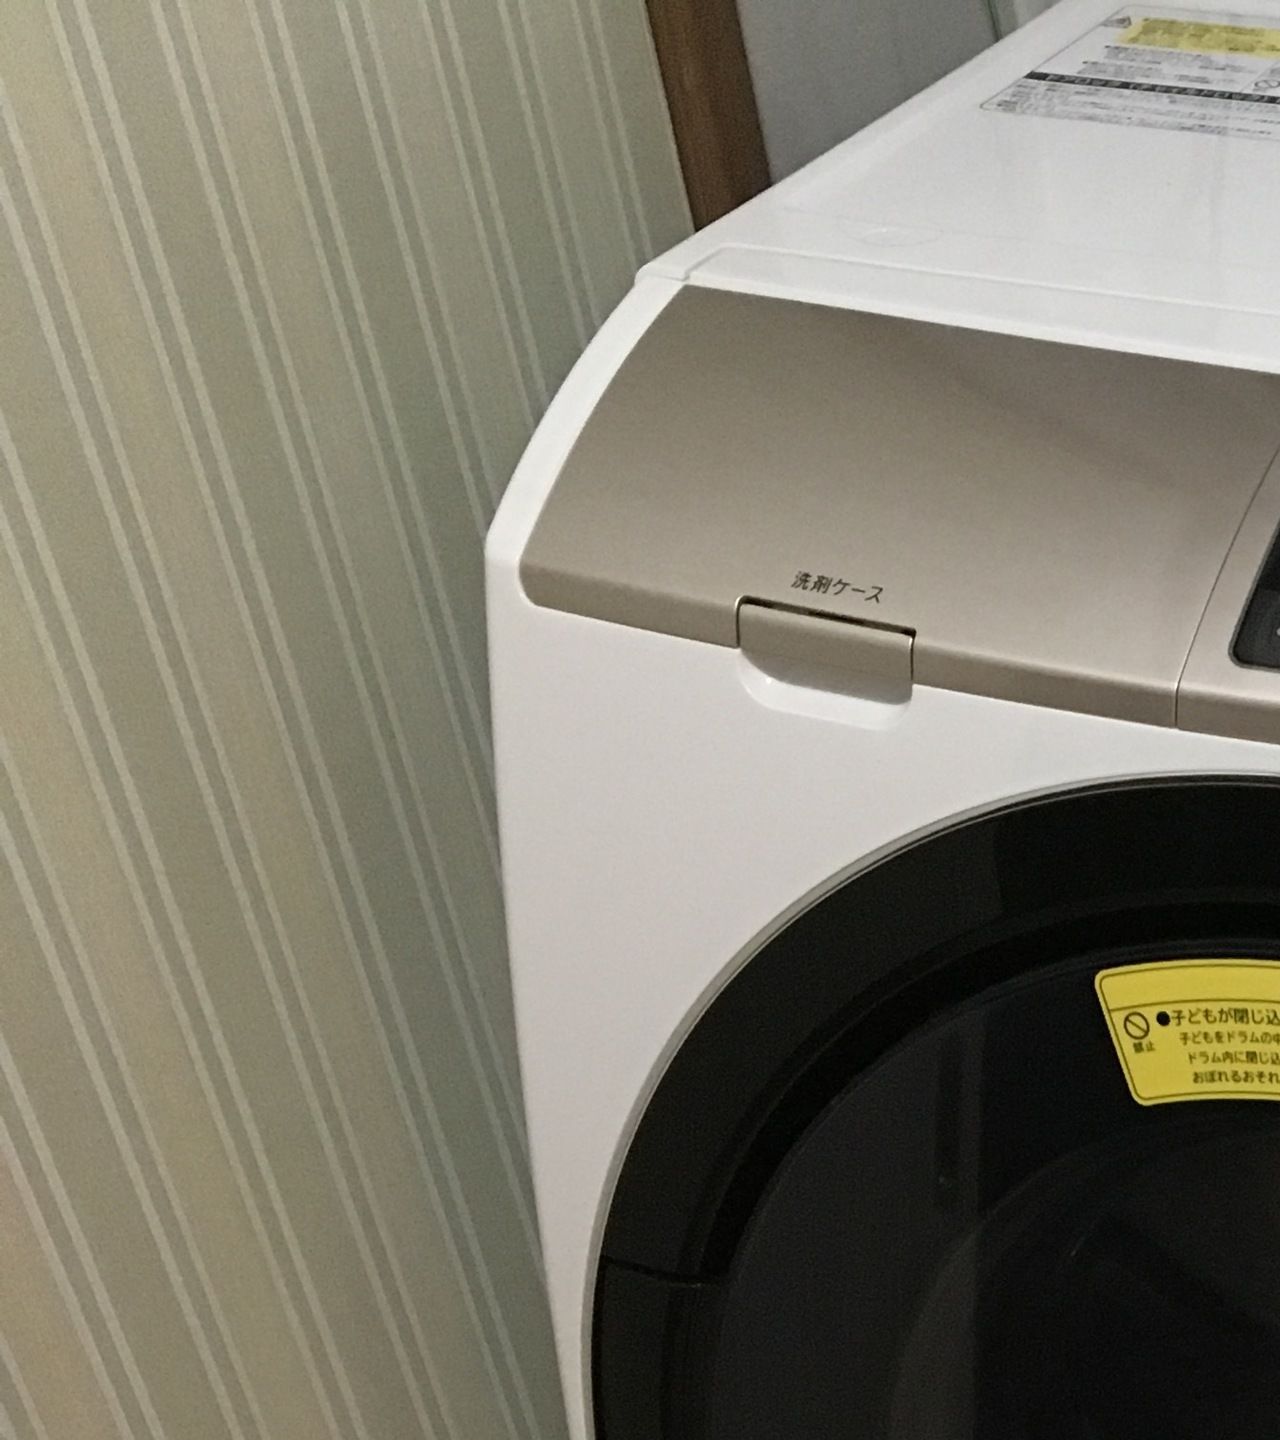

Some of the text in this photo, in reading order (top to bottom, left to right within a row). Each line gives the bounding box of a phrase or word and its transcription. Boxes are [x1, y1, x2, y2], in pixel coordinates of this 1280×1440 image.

[792, 571, 884, 603] 洗剤ケース
